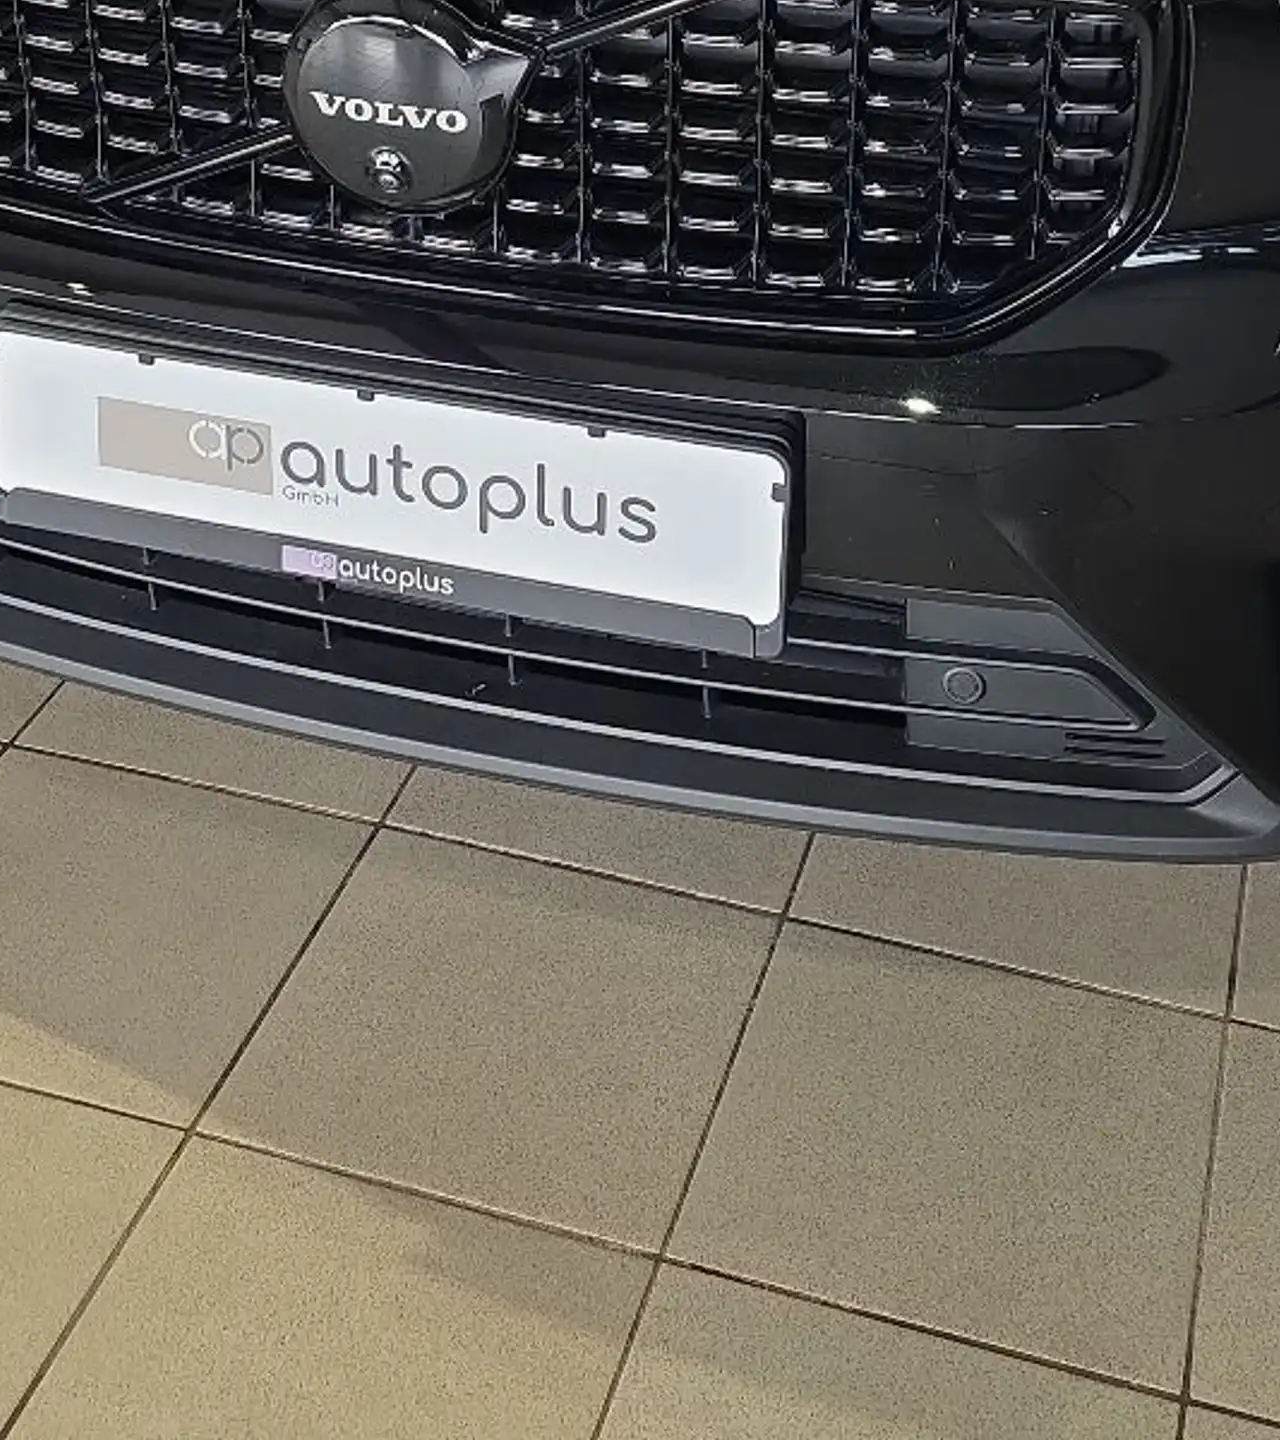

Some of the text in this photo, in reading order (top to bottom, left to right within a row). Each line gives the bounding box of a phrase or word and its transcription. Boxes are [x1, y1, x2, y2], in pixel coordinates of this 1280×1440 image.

[308, 90, 468, 134] VOLVO
[280, 440, 658, 544] autoplus
[282, 485, 339, 507] GmbH
[339, 559, 455, 595] autoplus
